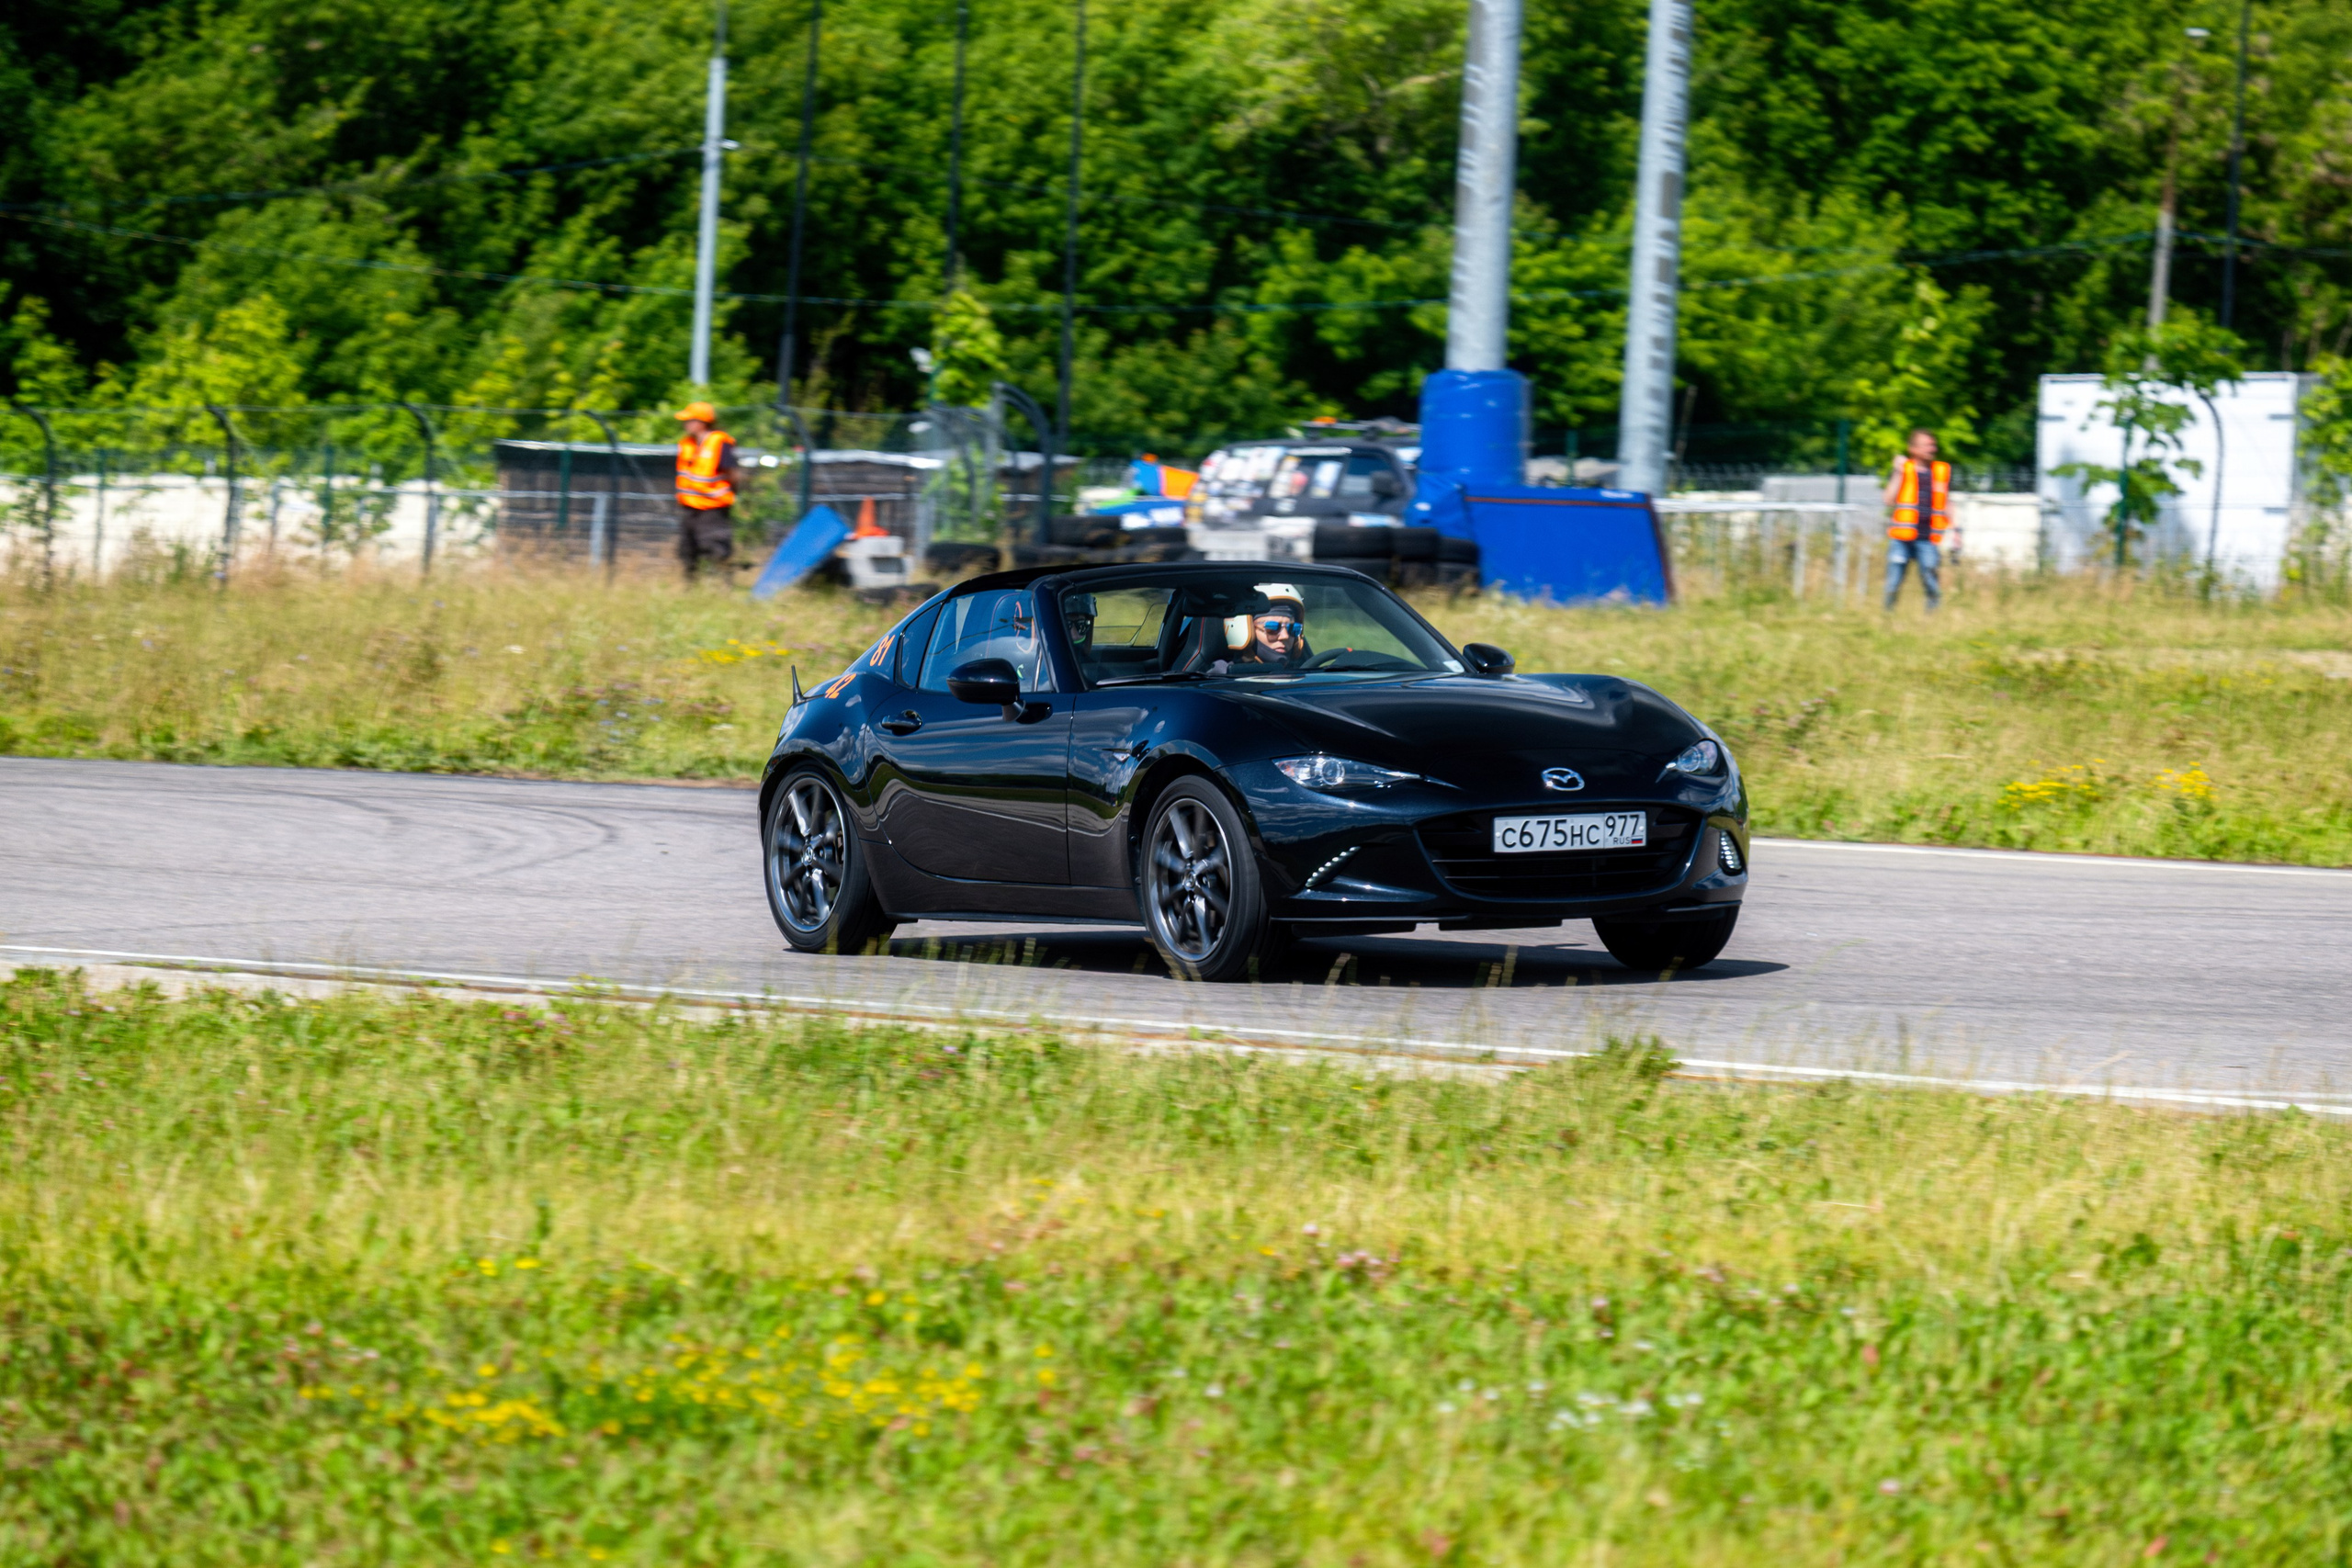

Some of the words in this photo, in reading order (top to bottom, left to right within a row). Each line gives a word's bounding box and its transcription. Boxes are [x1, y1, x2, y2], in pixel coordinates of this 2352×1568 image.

[869, 635, 896, 667] 81
[1605, 814, 1640, 837] 977
[1612, 837, 1631, 845] RUS
